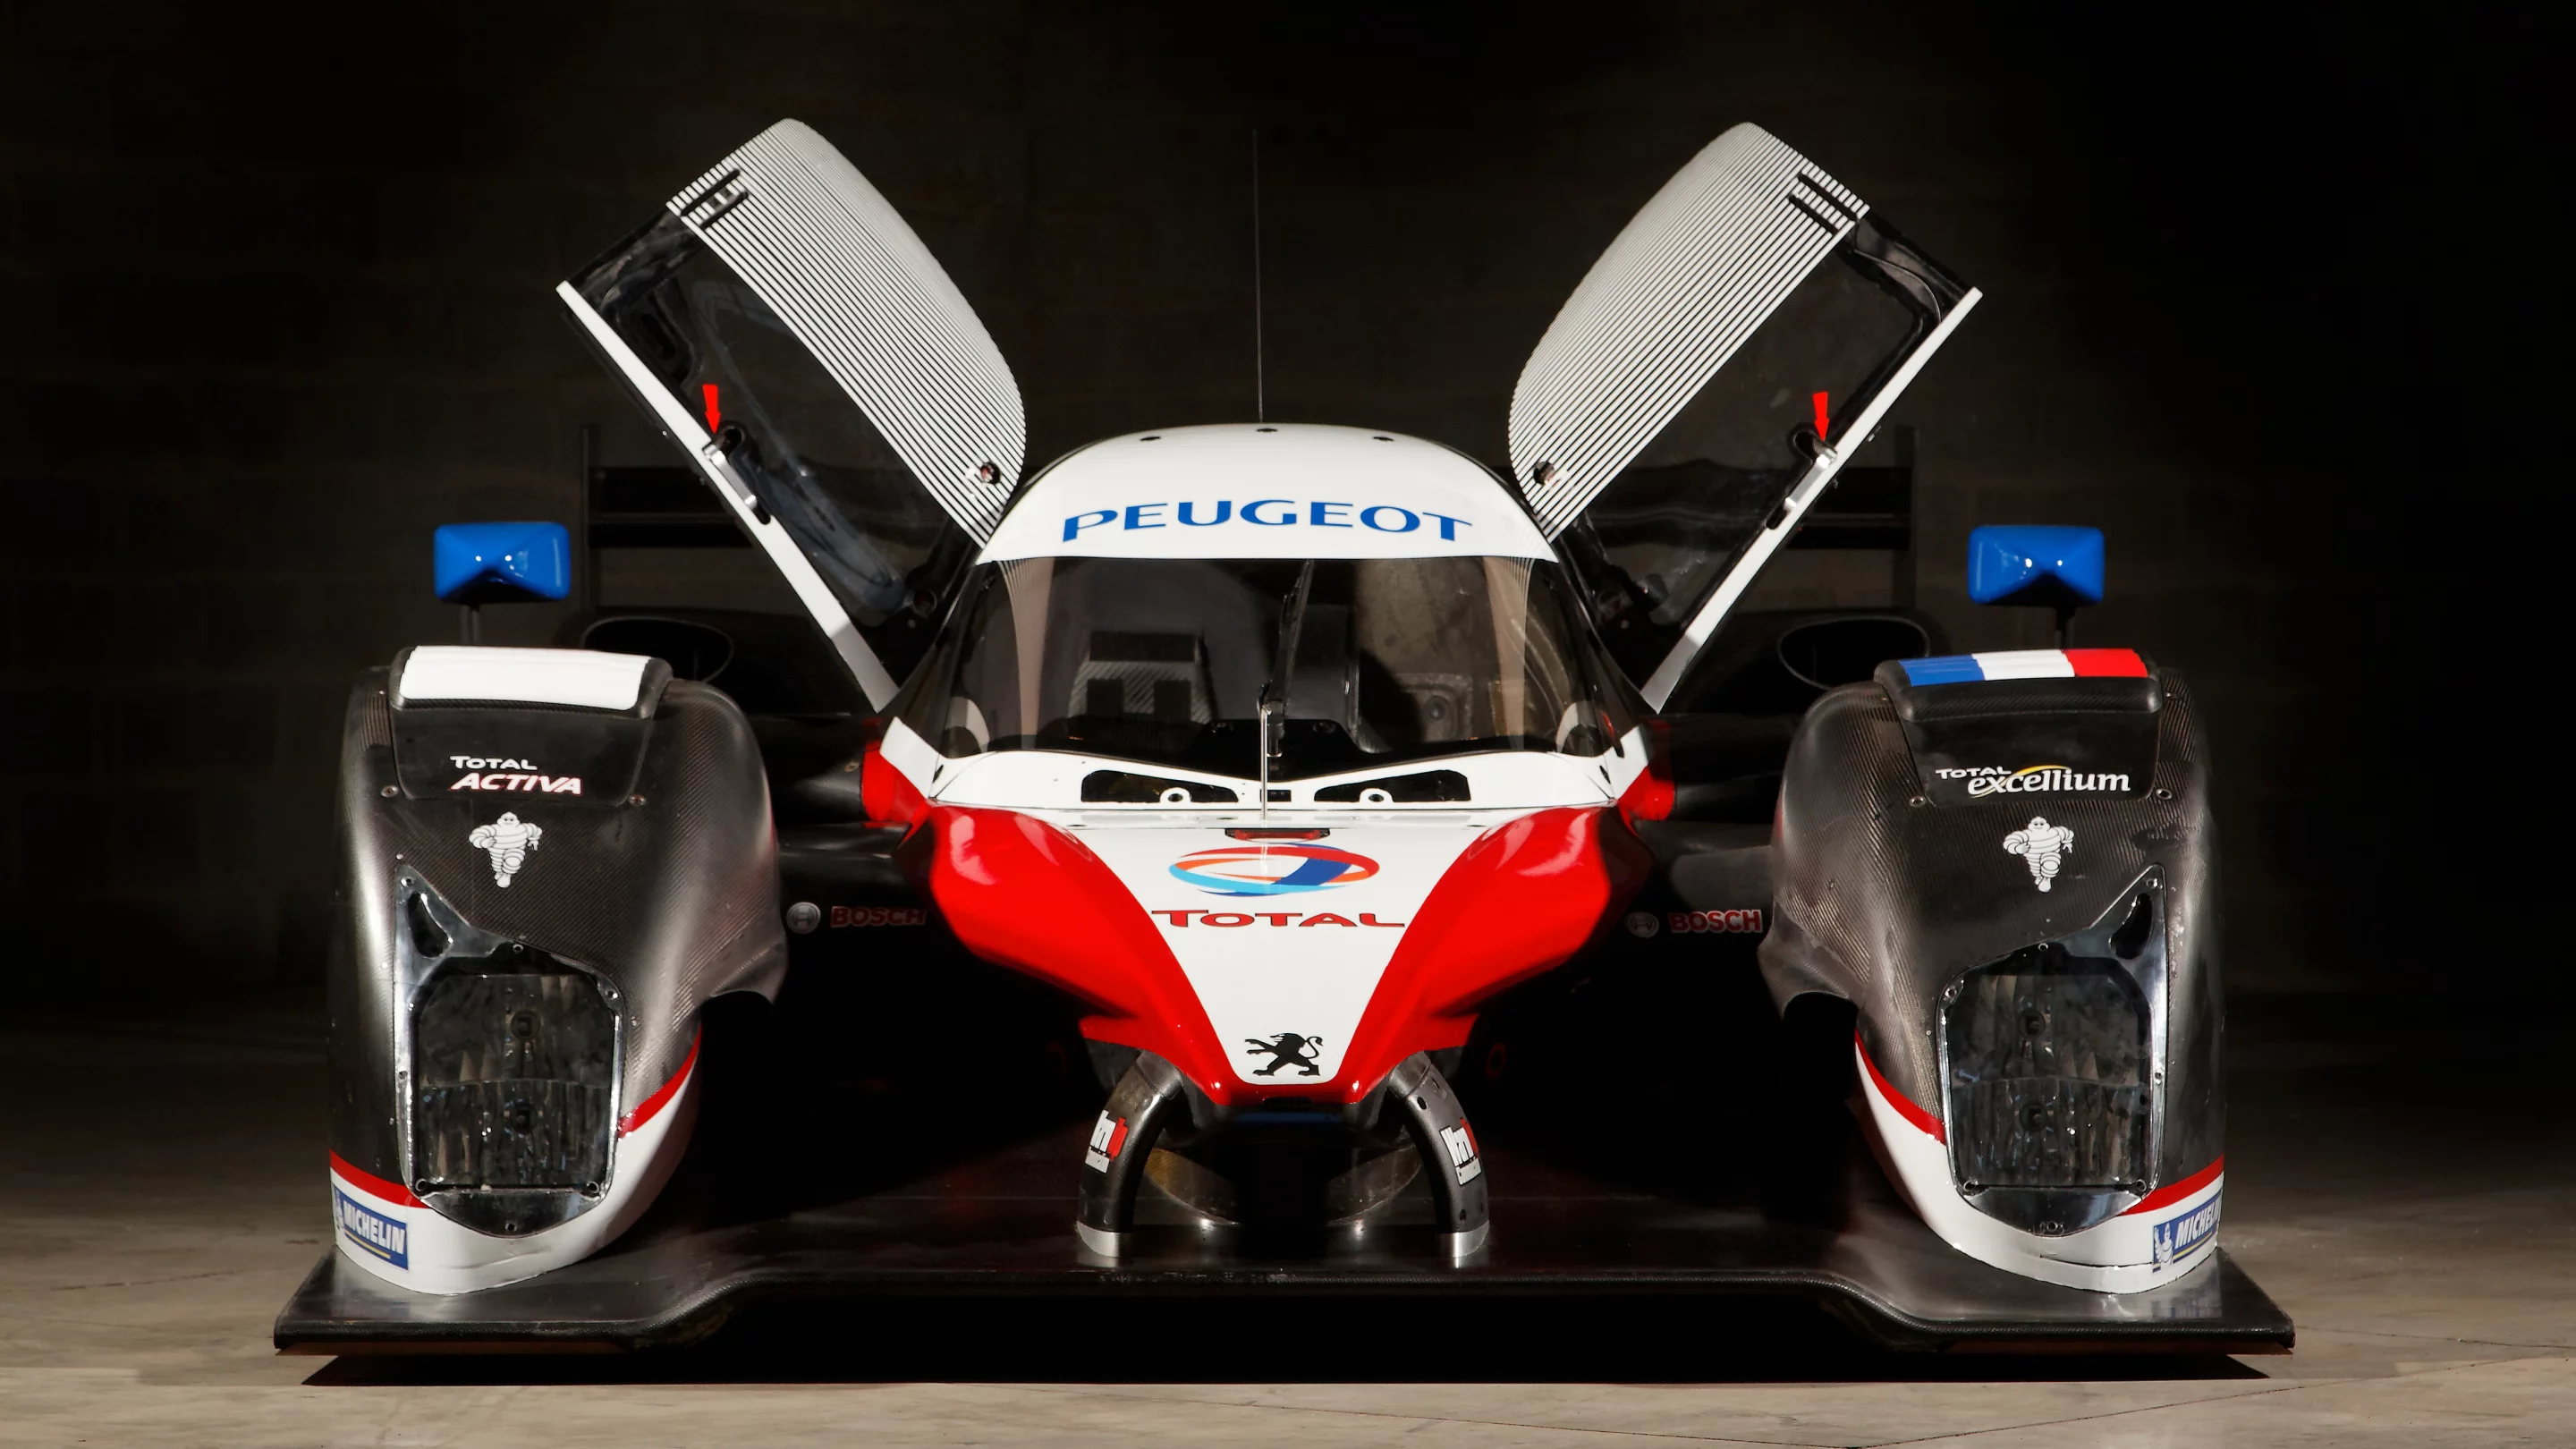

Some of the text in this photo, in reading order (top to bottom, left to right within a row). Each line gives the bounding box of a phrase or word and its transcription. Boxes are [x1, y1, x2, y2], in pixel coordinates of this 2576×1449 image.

[1062, 499, 1473, 542] PEUGEOT
[449, 755, 538, 770] TOTAL
[1935, 766, 2012, 780] TOTAL
[448, 772, 583, 796] ACTIVA
[1967, 768, 2131, 795] excellium
[830, 905, 927, 928] BOSCH
[1151, 910, 1406, 928] TOTAL
[1667, 909, 1764, 934] BOSCH
[343, 1199, 405, 1255] MICHELIN
[2174, 1197, 2220, 1250] MICHEL
